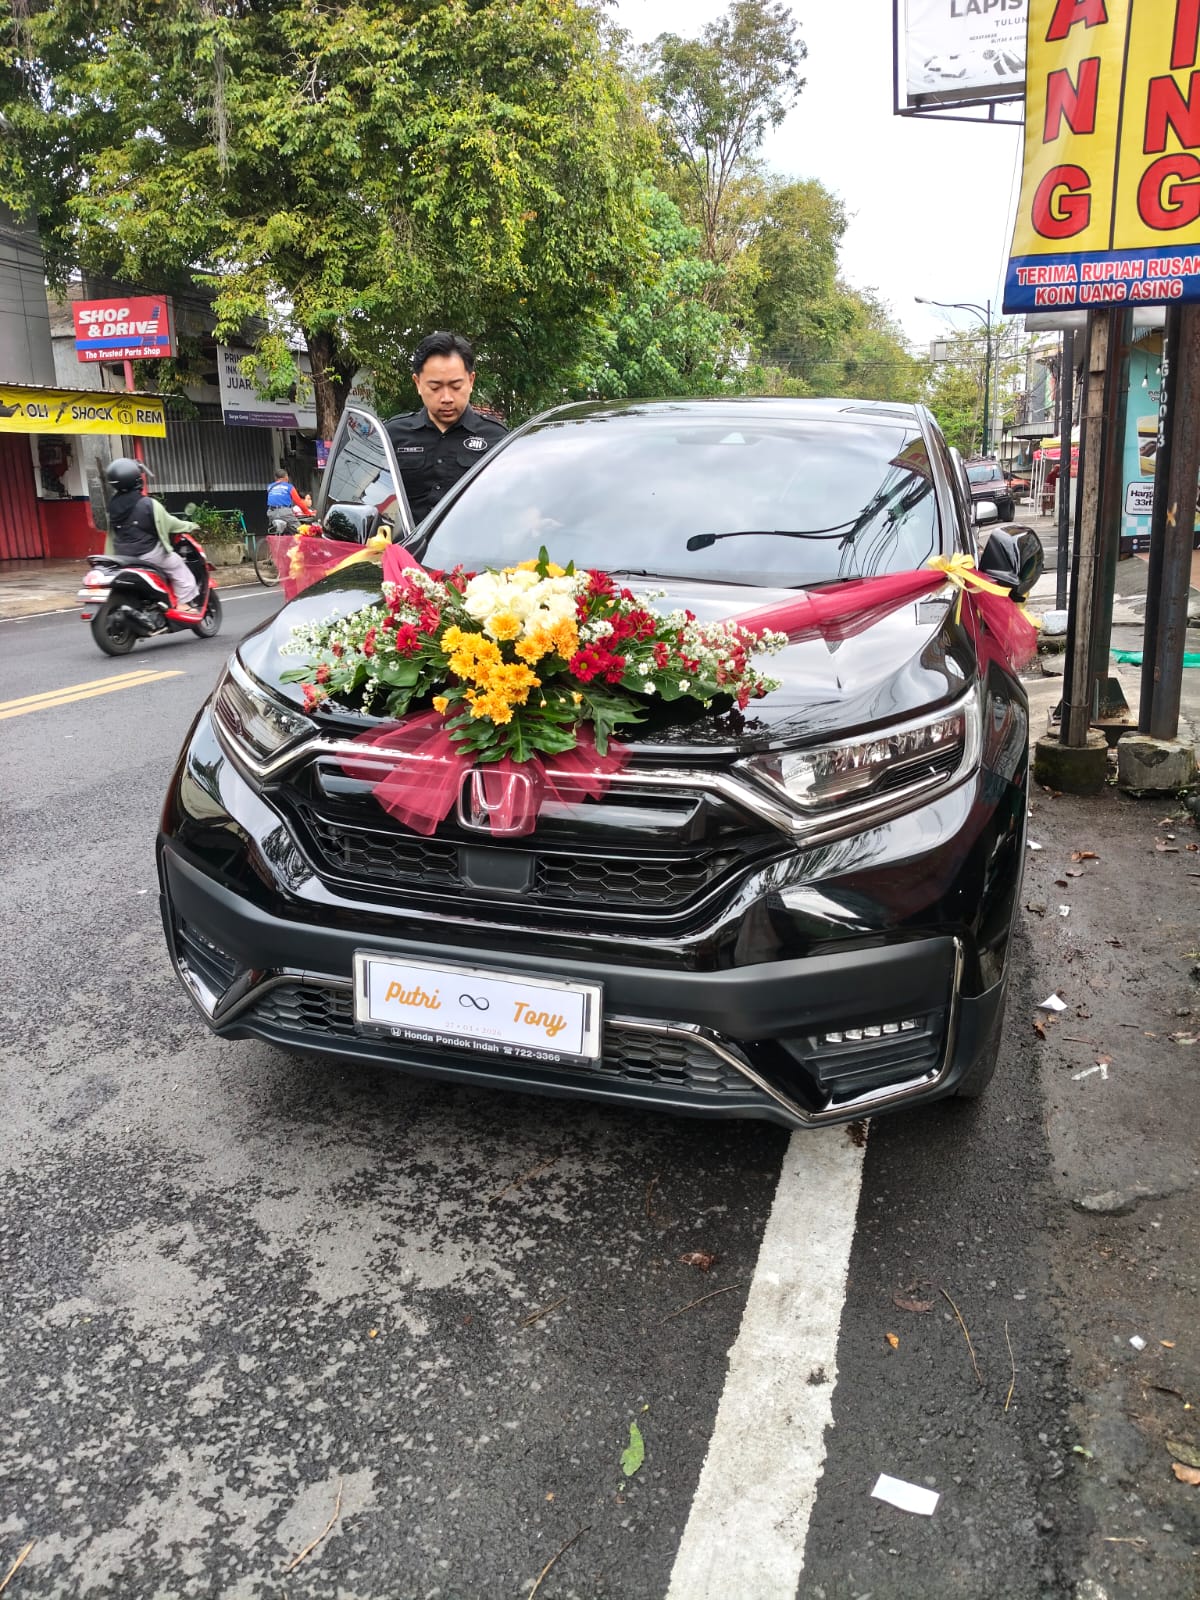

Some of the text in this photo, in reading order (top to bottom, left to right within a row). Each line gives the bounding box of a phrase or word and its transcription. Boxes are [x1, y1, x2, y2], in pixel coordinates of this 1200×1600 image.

[1017, 263, 1077, 286] TERIMA
[1081, 259, 1144, 282] RUPIAH
[1034, 279, 1183, 306] KOIN UANG ASING
[78, 308, 130, 325] SHOP
[85, 347, 161, 359] The Trusted Parts Shop
[227, 377, 255, 391] JUAR
[26, 403, 49, 418] OLI
[71, 406, 114, 421] SHOCK
[136, 409, 163, 424] REM
[385, 981, 568, 1038] Putri Tony
[404, 1030, 434, 1042] Honda
[436, 1034, 471, 1048] Pondok
[473, 1040, 500, 1053] Indah
